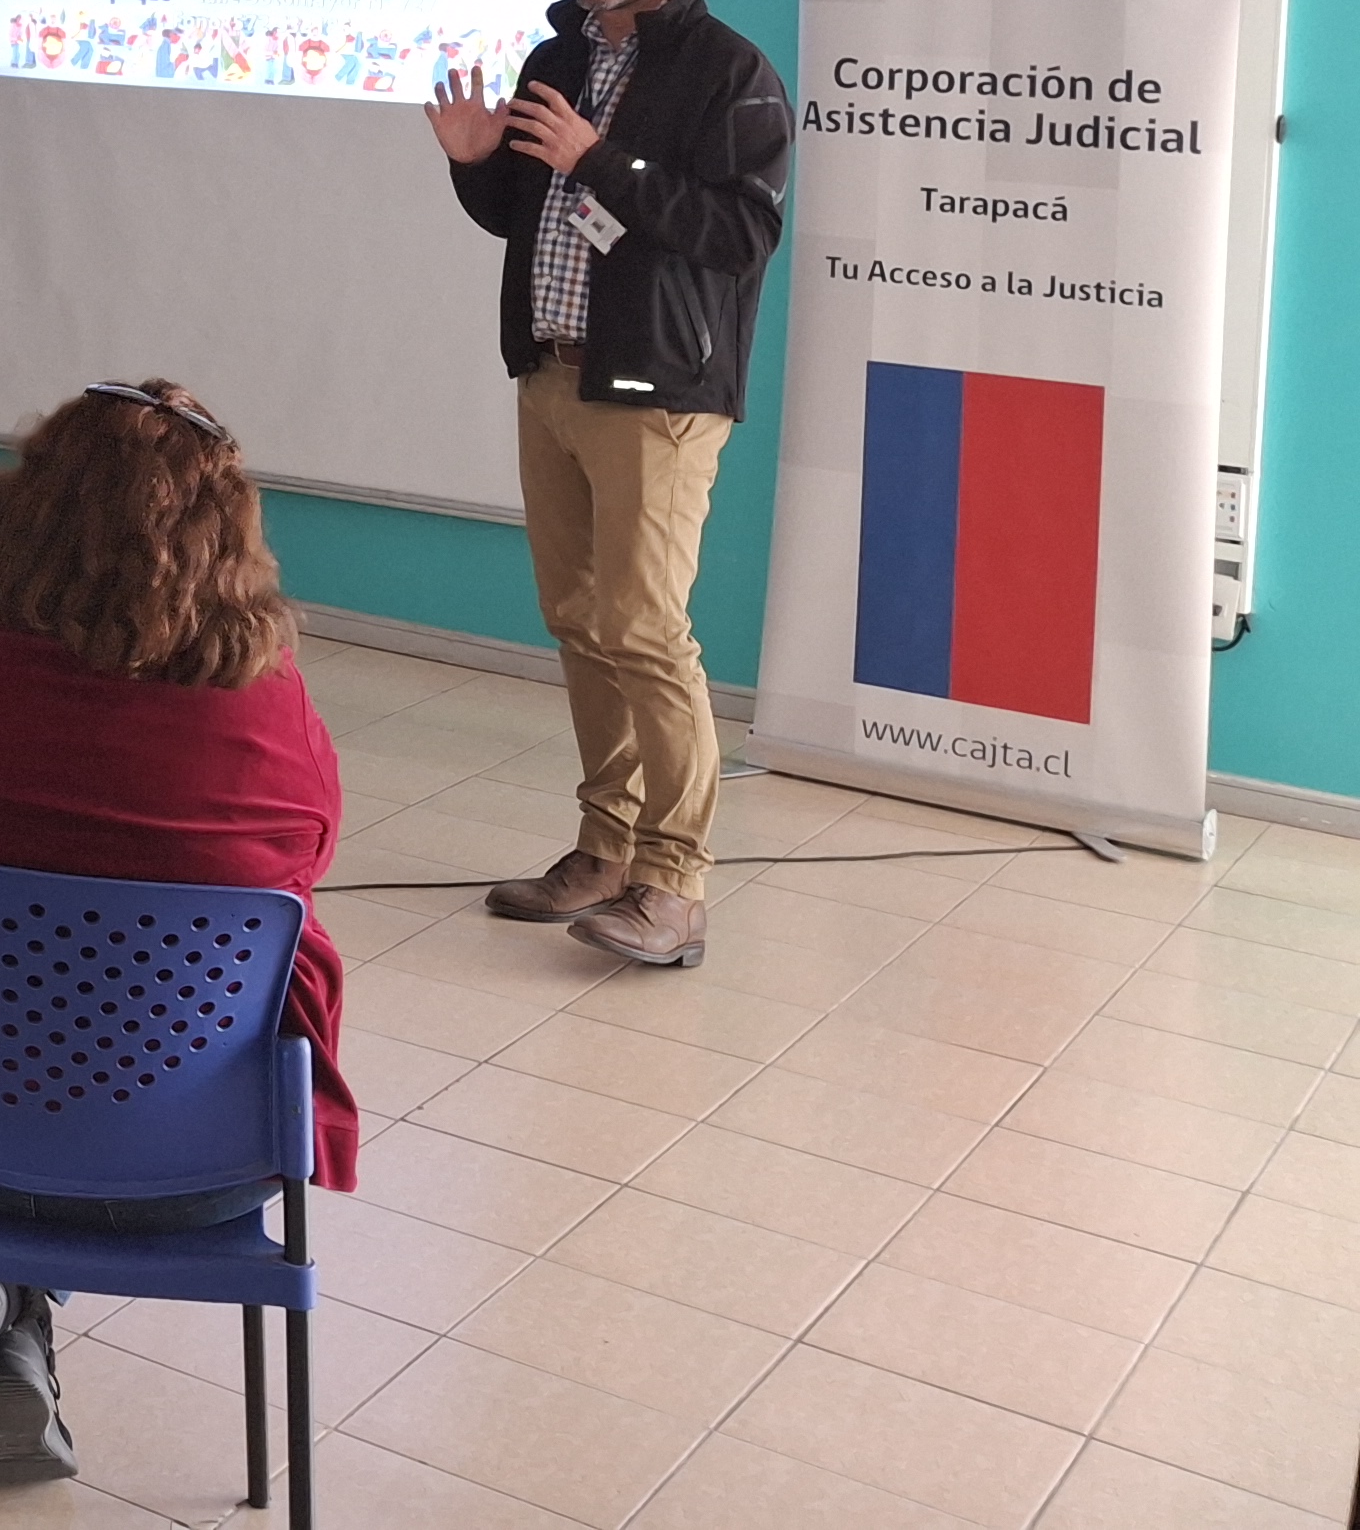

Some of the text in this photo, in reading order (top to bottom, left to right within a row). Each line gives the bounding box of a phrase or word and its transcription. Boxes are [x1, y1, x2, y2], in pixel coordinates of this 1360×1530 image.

[833, 57, 1162, 104] Corporación de
[802, 100, 1202, 155] Asistencia Judicial
[920, 186, 1069, 223] Tarapacá
[826, 255, 1164, 309] Tu Acceso a la Justicia
[862, 718, 1072, 778] www.cajta.cl
